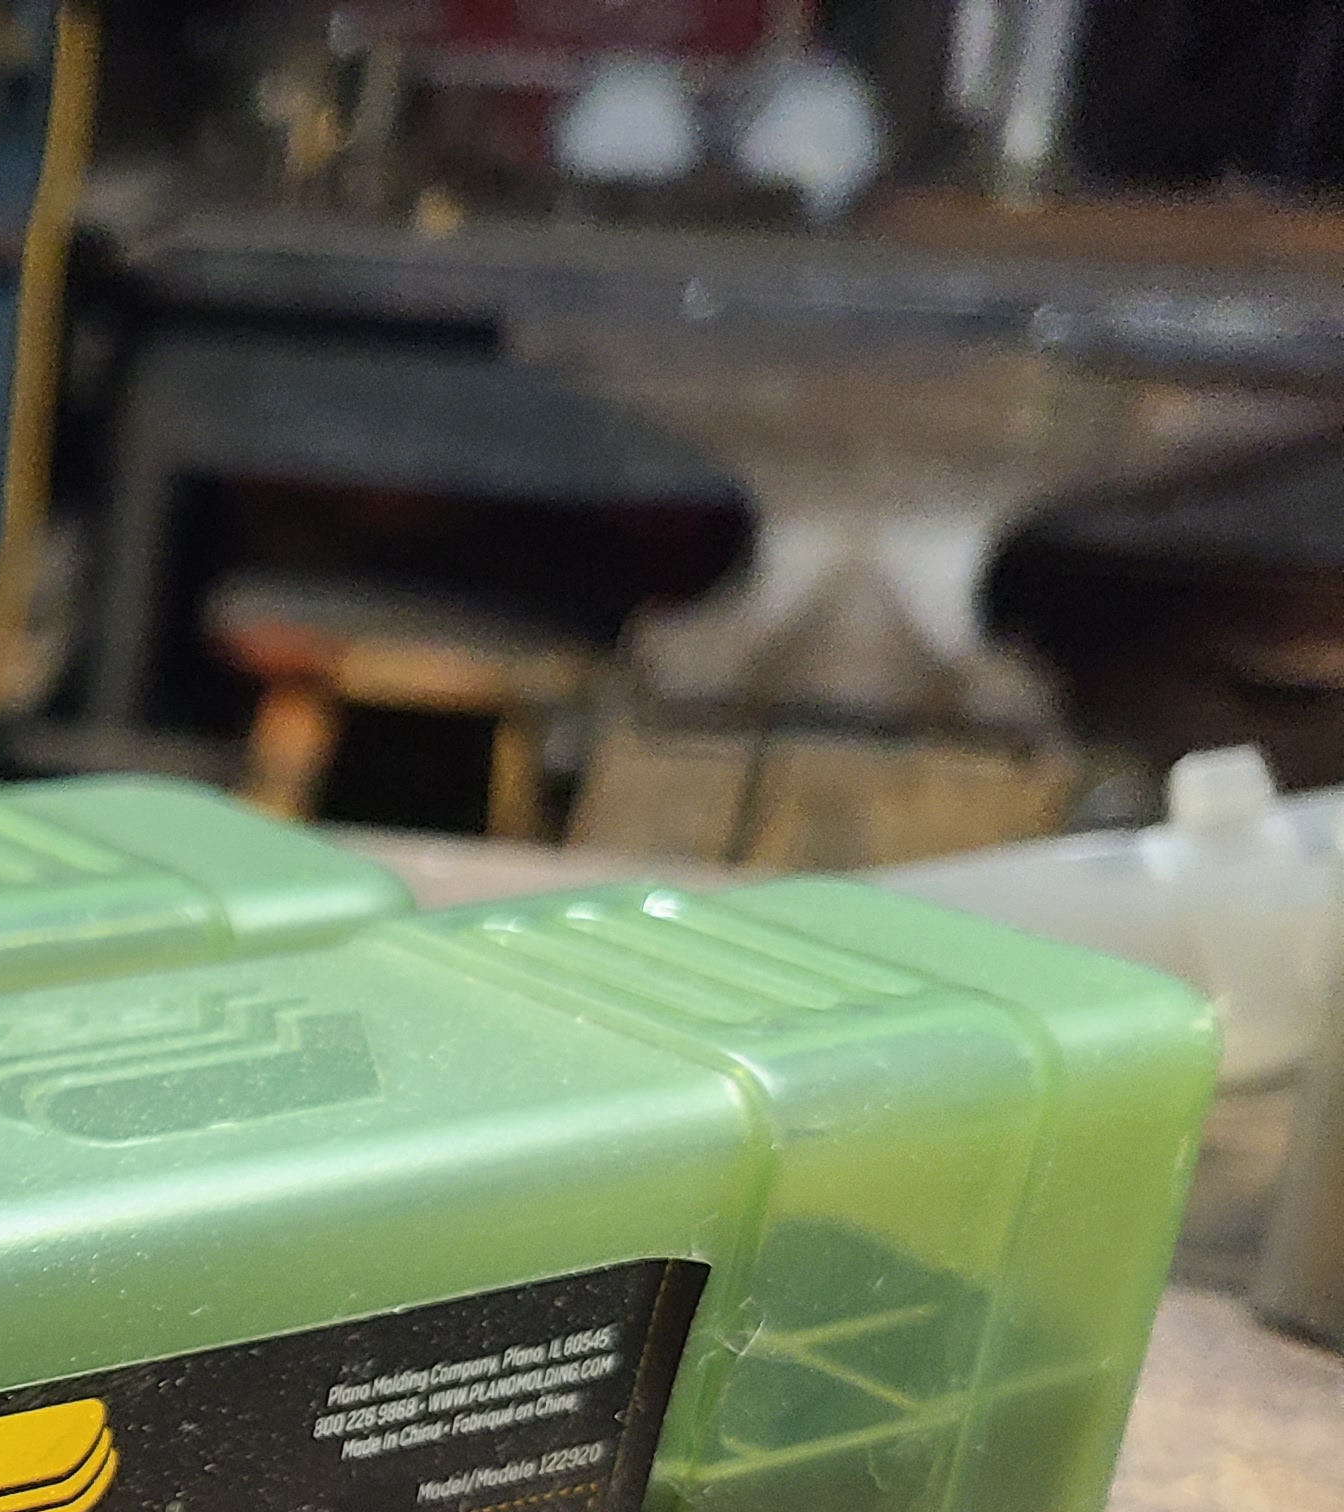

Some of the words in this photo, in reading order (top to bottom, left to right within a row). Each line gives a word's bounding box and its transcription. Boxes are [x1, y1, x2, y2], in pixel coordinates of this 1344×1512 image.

[327, 1382, 371, 1407] Plano
[372, 1370, 430, 1397] Molding
[430, 1356, 500, 1384] Company,
[548, 1337, 562, 1361] IL
[341, 1436, 382, 1462] Made
[399, 1422, 444, 1447] China
[515, 1400, 534, 1421] en
[538, 1442, 604, 1475] 122920
